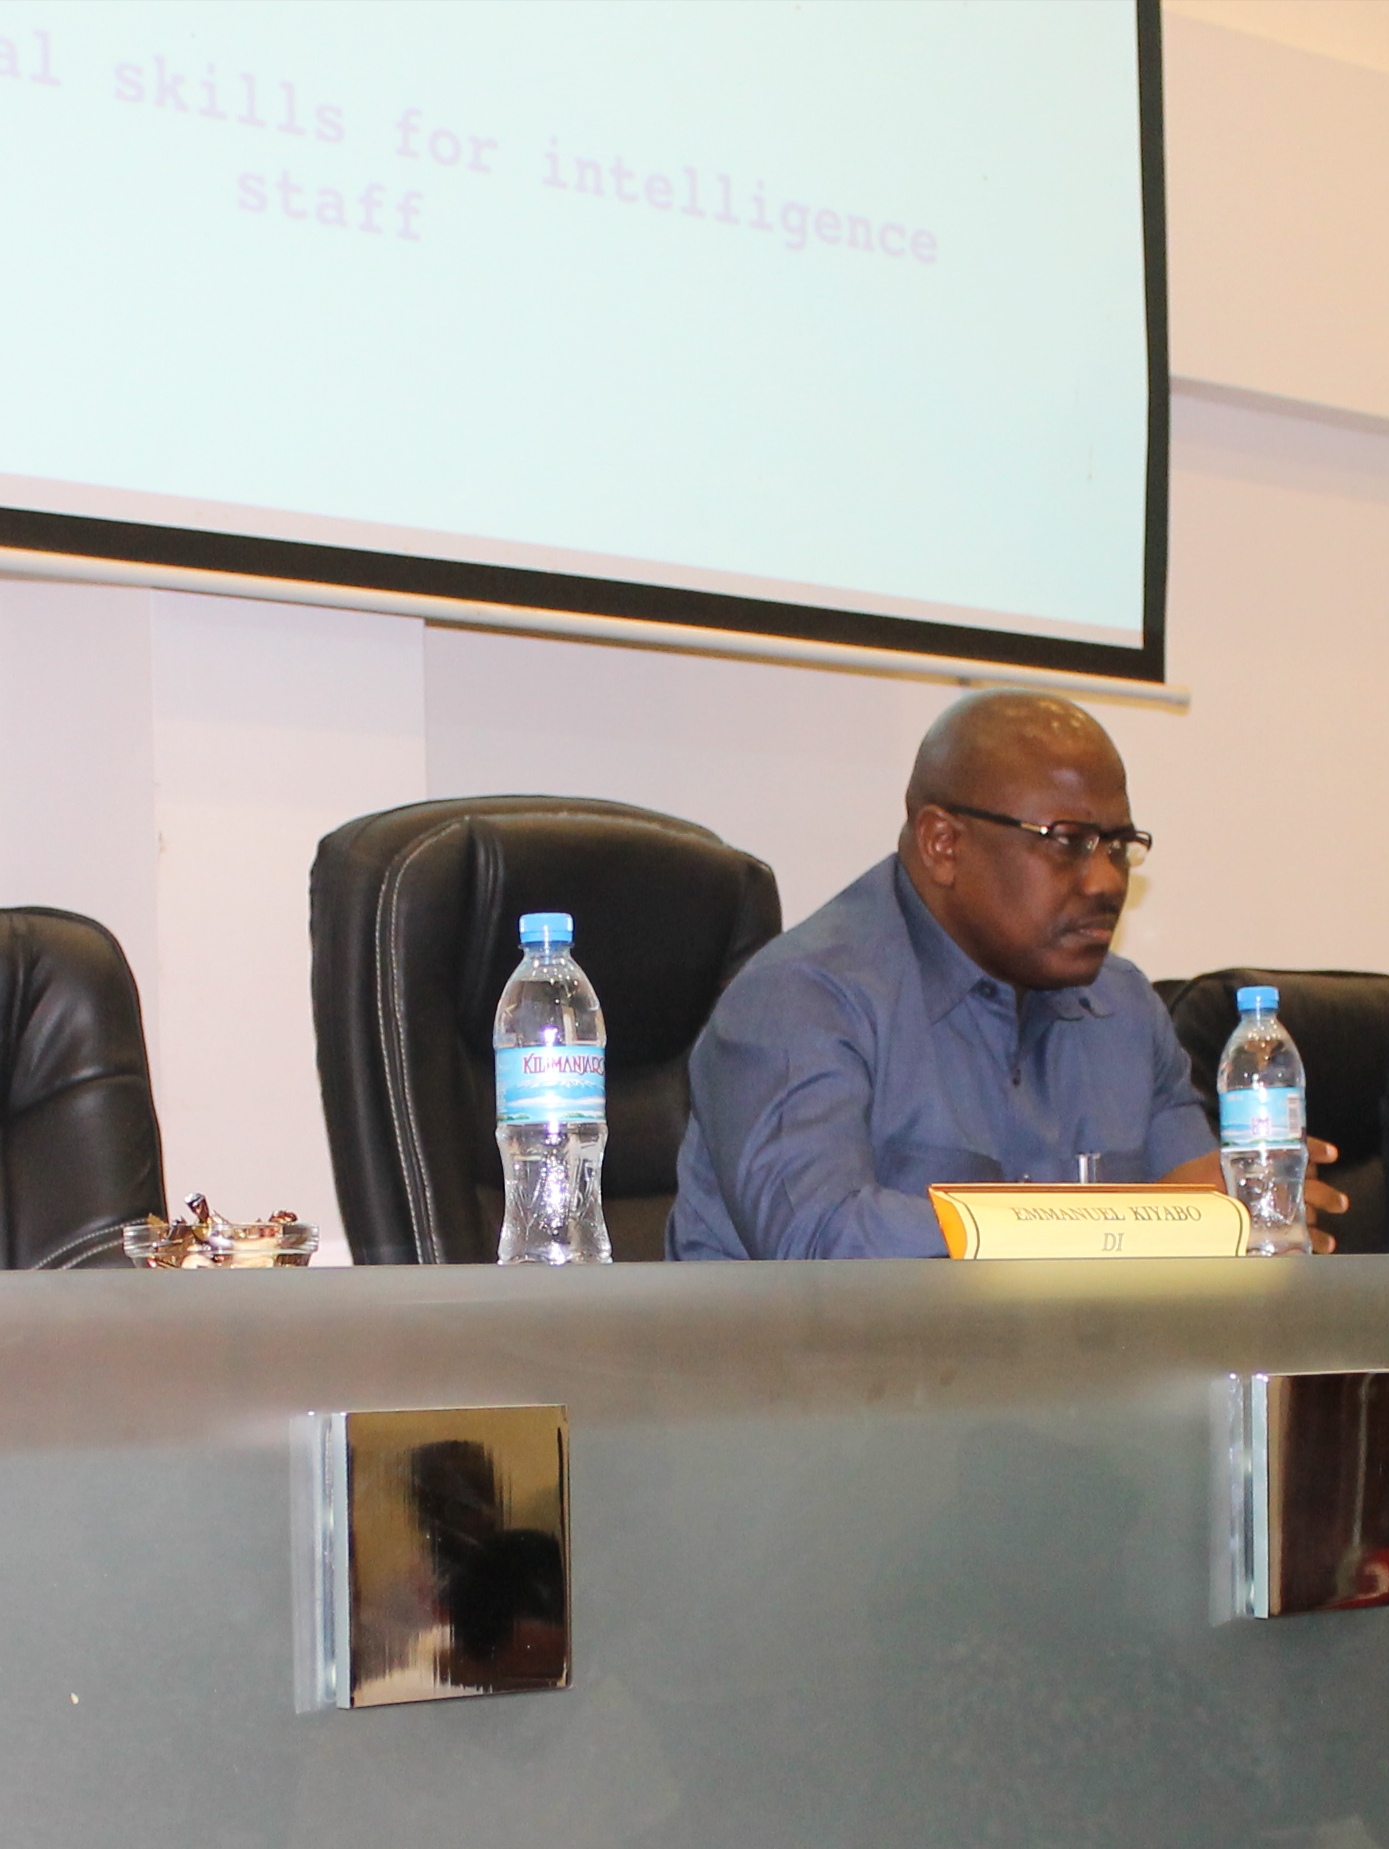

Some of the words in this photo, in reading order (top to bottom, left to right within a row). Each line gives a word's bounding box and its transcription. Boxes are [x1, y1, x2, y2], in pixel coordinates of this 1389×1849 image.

[113, 53, 346, 145] skills
[394, 106, 500, 175] for
[541, 135, 939, 266] intelligence
[236, 169, 424, 243] staff
[1010, 1206, 1127, 1222] EMMANUEL
[1128, 1205, 1202, 1222] KIYABO
[1102, 1232, 1125, 1252] DI
